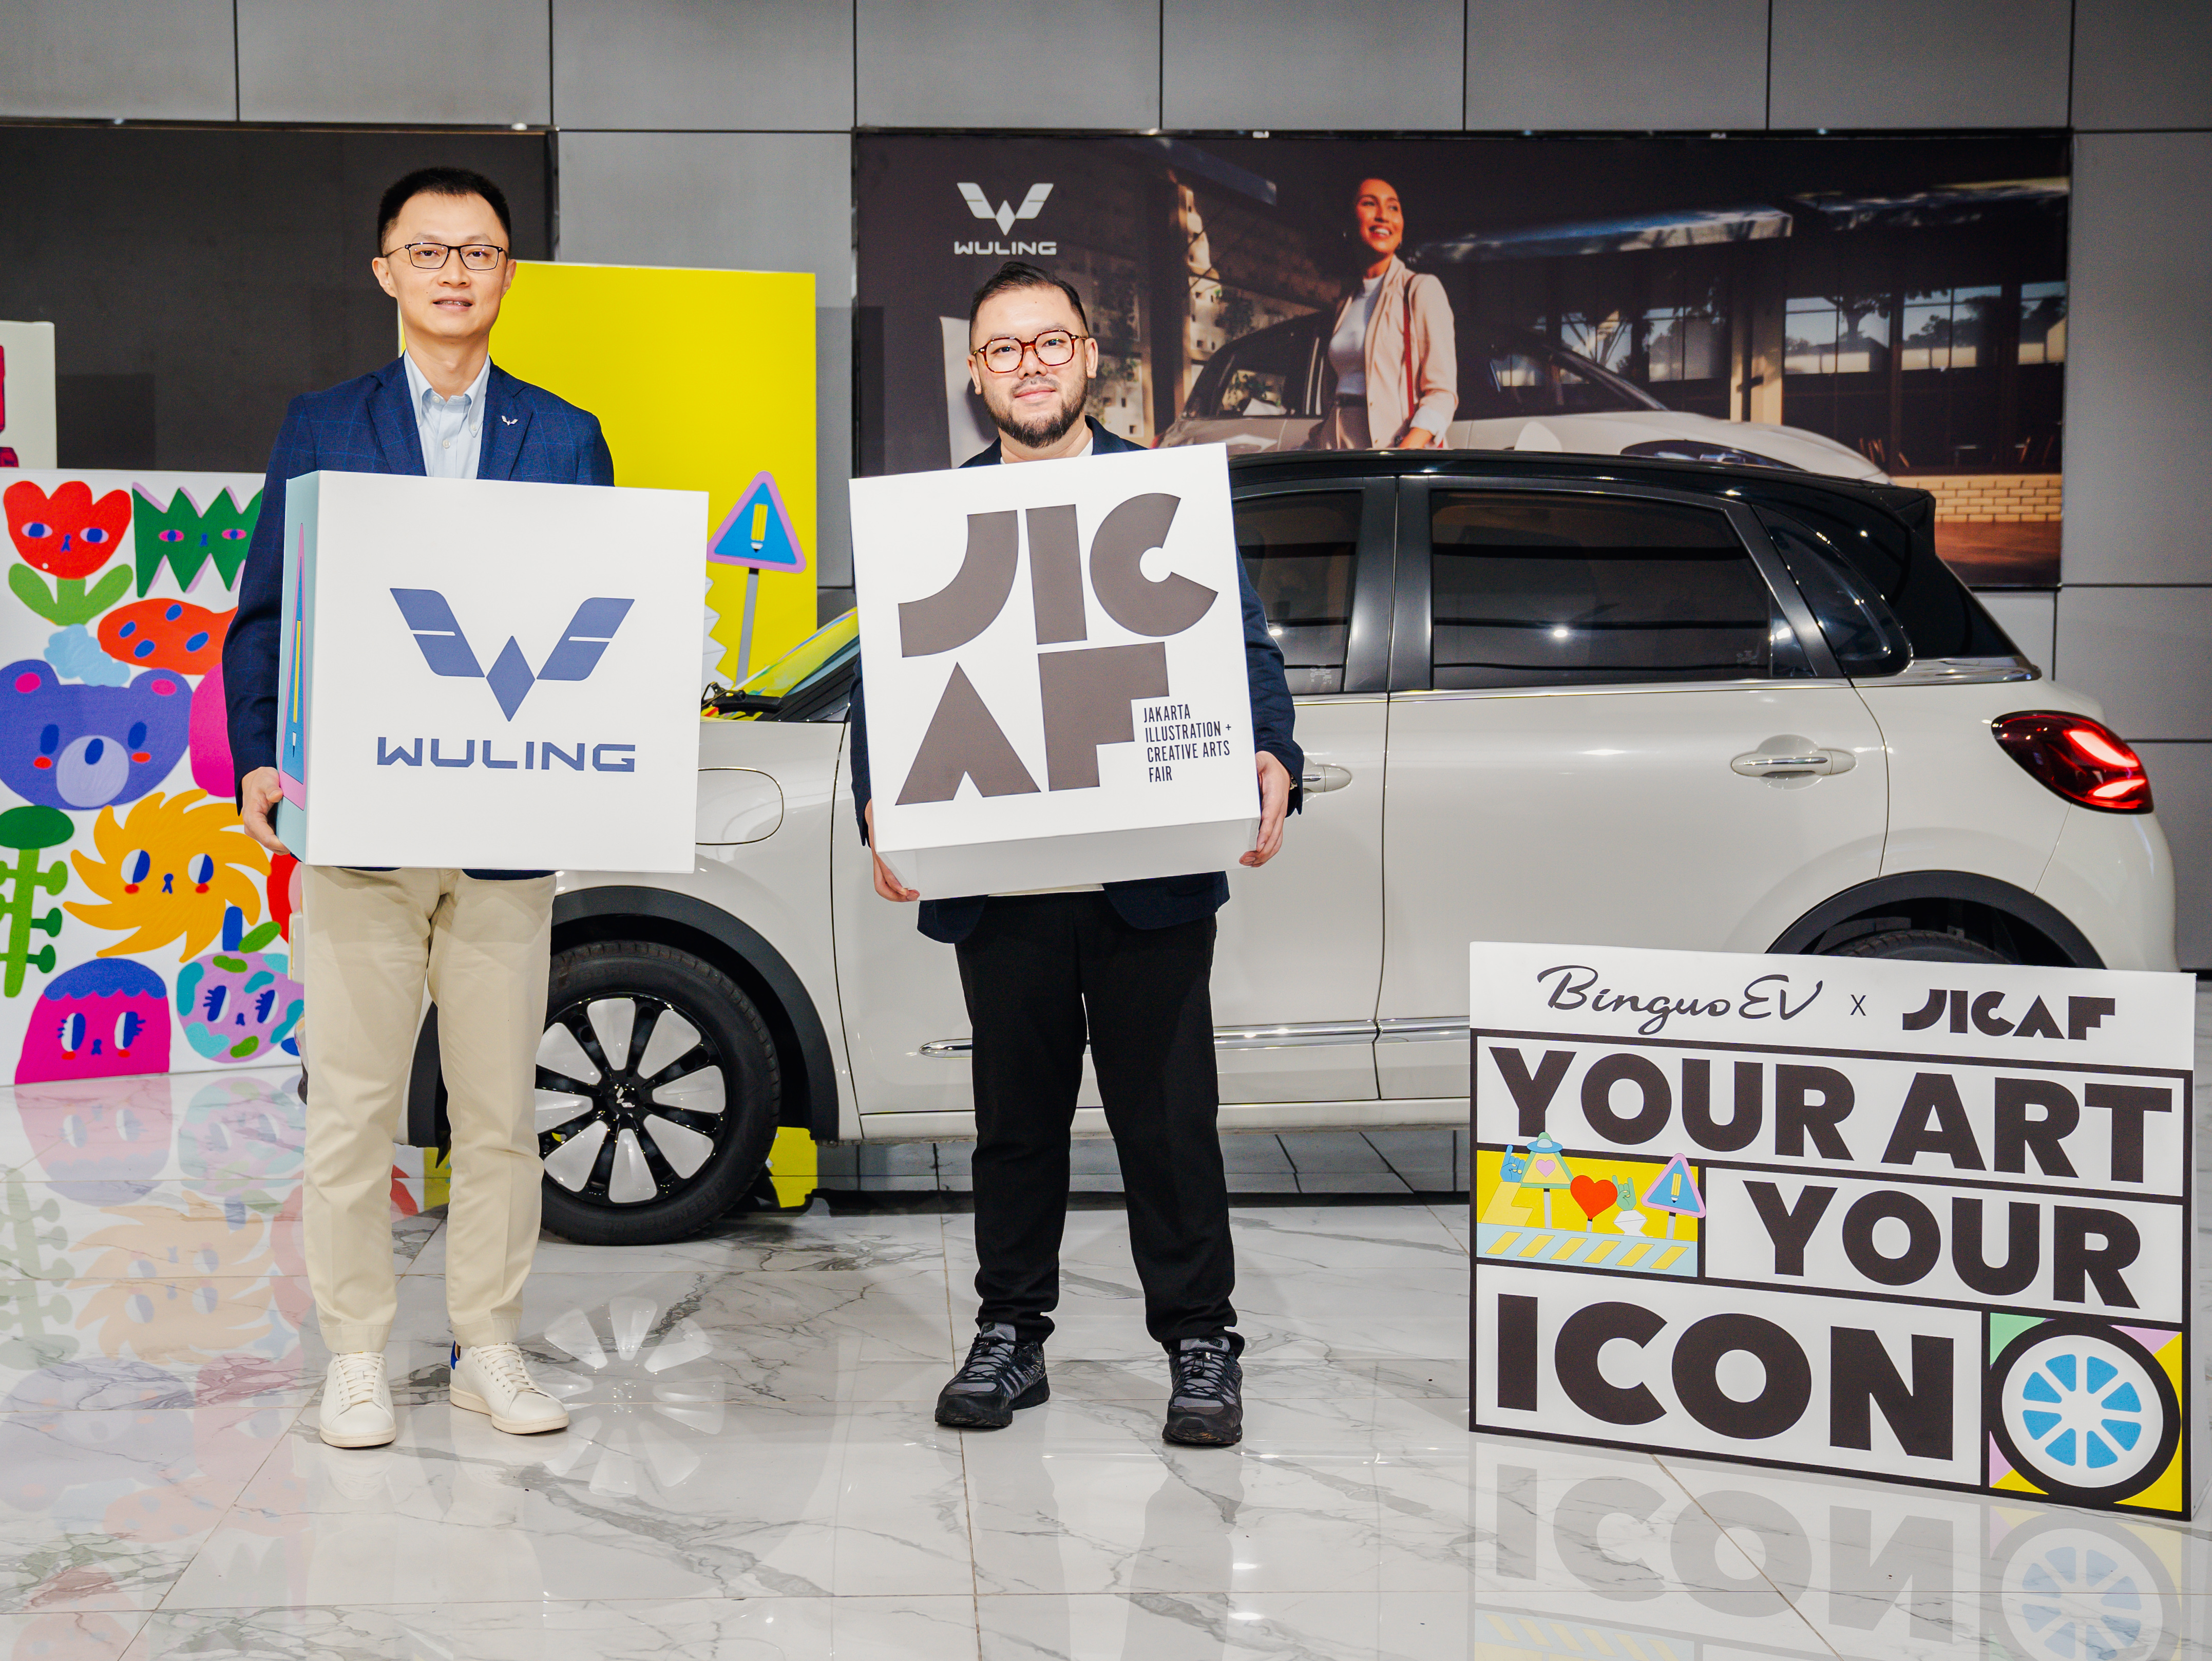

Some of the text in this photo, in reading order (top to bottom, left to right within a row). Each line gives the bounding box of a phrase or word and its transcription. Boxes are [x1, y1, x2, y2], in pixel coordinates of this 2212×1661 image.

[954, 241, 1057, 255] WULING
[898, 493, 1219, 658] JIC
[894, 641, 1170, 806] AF
[1144, 704, 1191, 723] JAKARTA
[1145, 721, 1221, 743] ILLUSTRATION
[377, 737, 636, 772] WULING
[1147, 740, 1230, 763] CREATIVE ARTS
[1149, 766, 1173, 783] FAIR
[1537, 965, 1730, 1035] Binguo
[1739, 974, 1823, 1020] EV
[1902, 989, 2115, 1041] JICAF
[1489, 1046, 2172, 1183] YOUR ART
[1742, 1180, 2141, 1309] YOUR
[1497, 1293, 1954, 1461] ICON
